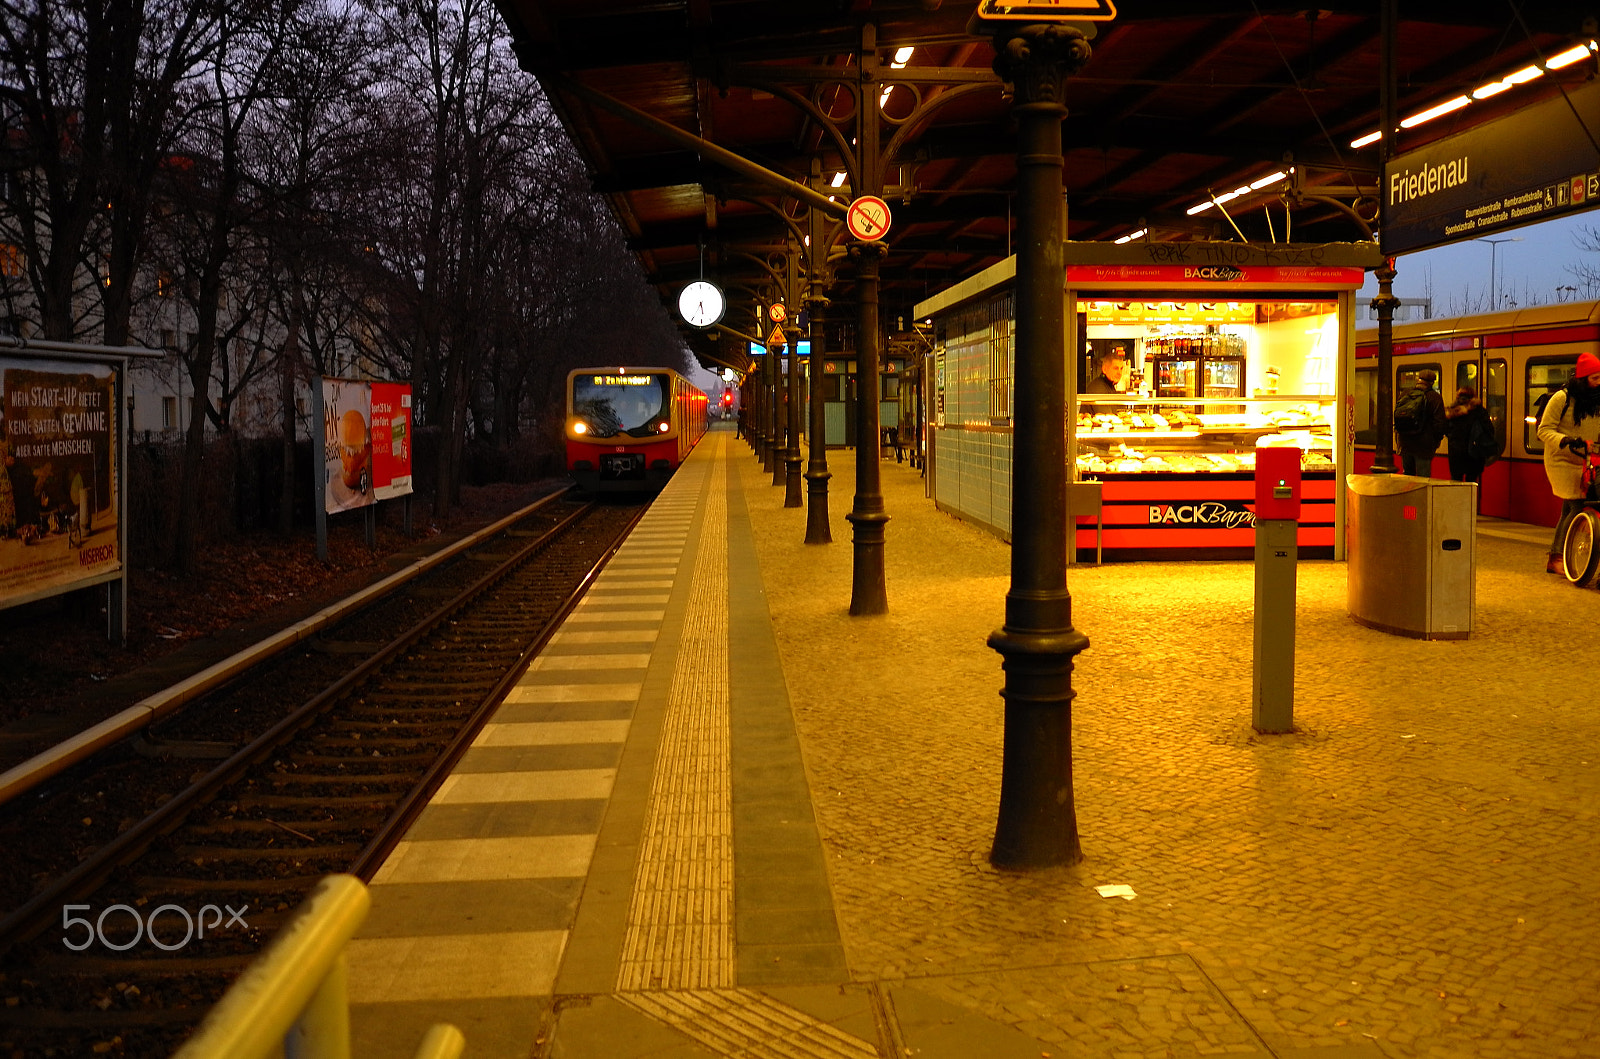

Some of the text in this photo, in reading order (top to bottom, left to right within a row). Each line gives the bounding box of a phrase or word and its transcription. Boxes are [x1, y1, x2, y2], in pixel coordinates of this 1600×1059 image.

[1390, 156, 1468, 206] Friedenau
[1573, 185, 1583, 195] BUS
[1465, 189, 1543, 219] Baumeisterstraße Rembrandtstraße
[1477, 211, 1509, 227] Cranachstraße
[11, 386, 102, 408] MEIN START-UP BIETET
[8, 411, 108, 436] KEINE SATTEN GEWINNE.
[32, 443, 51, 457] SATTE
[51, 438, 94, 456] MENSCHEN.
[79, 544, 114, 567] MISEREOR
